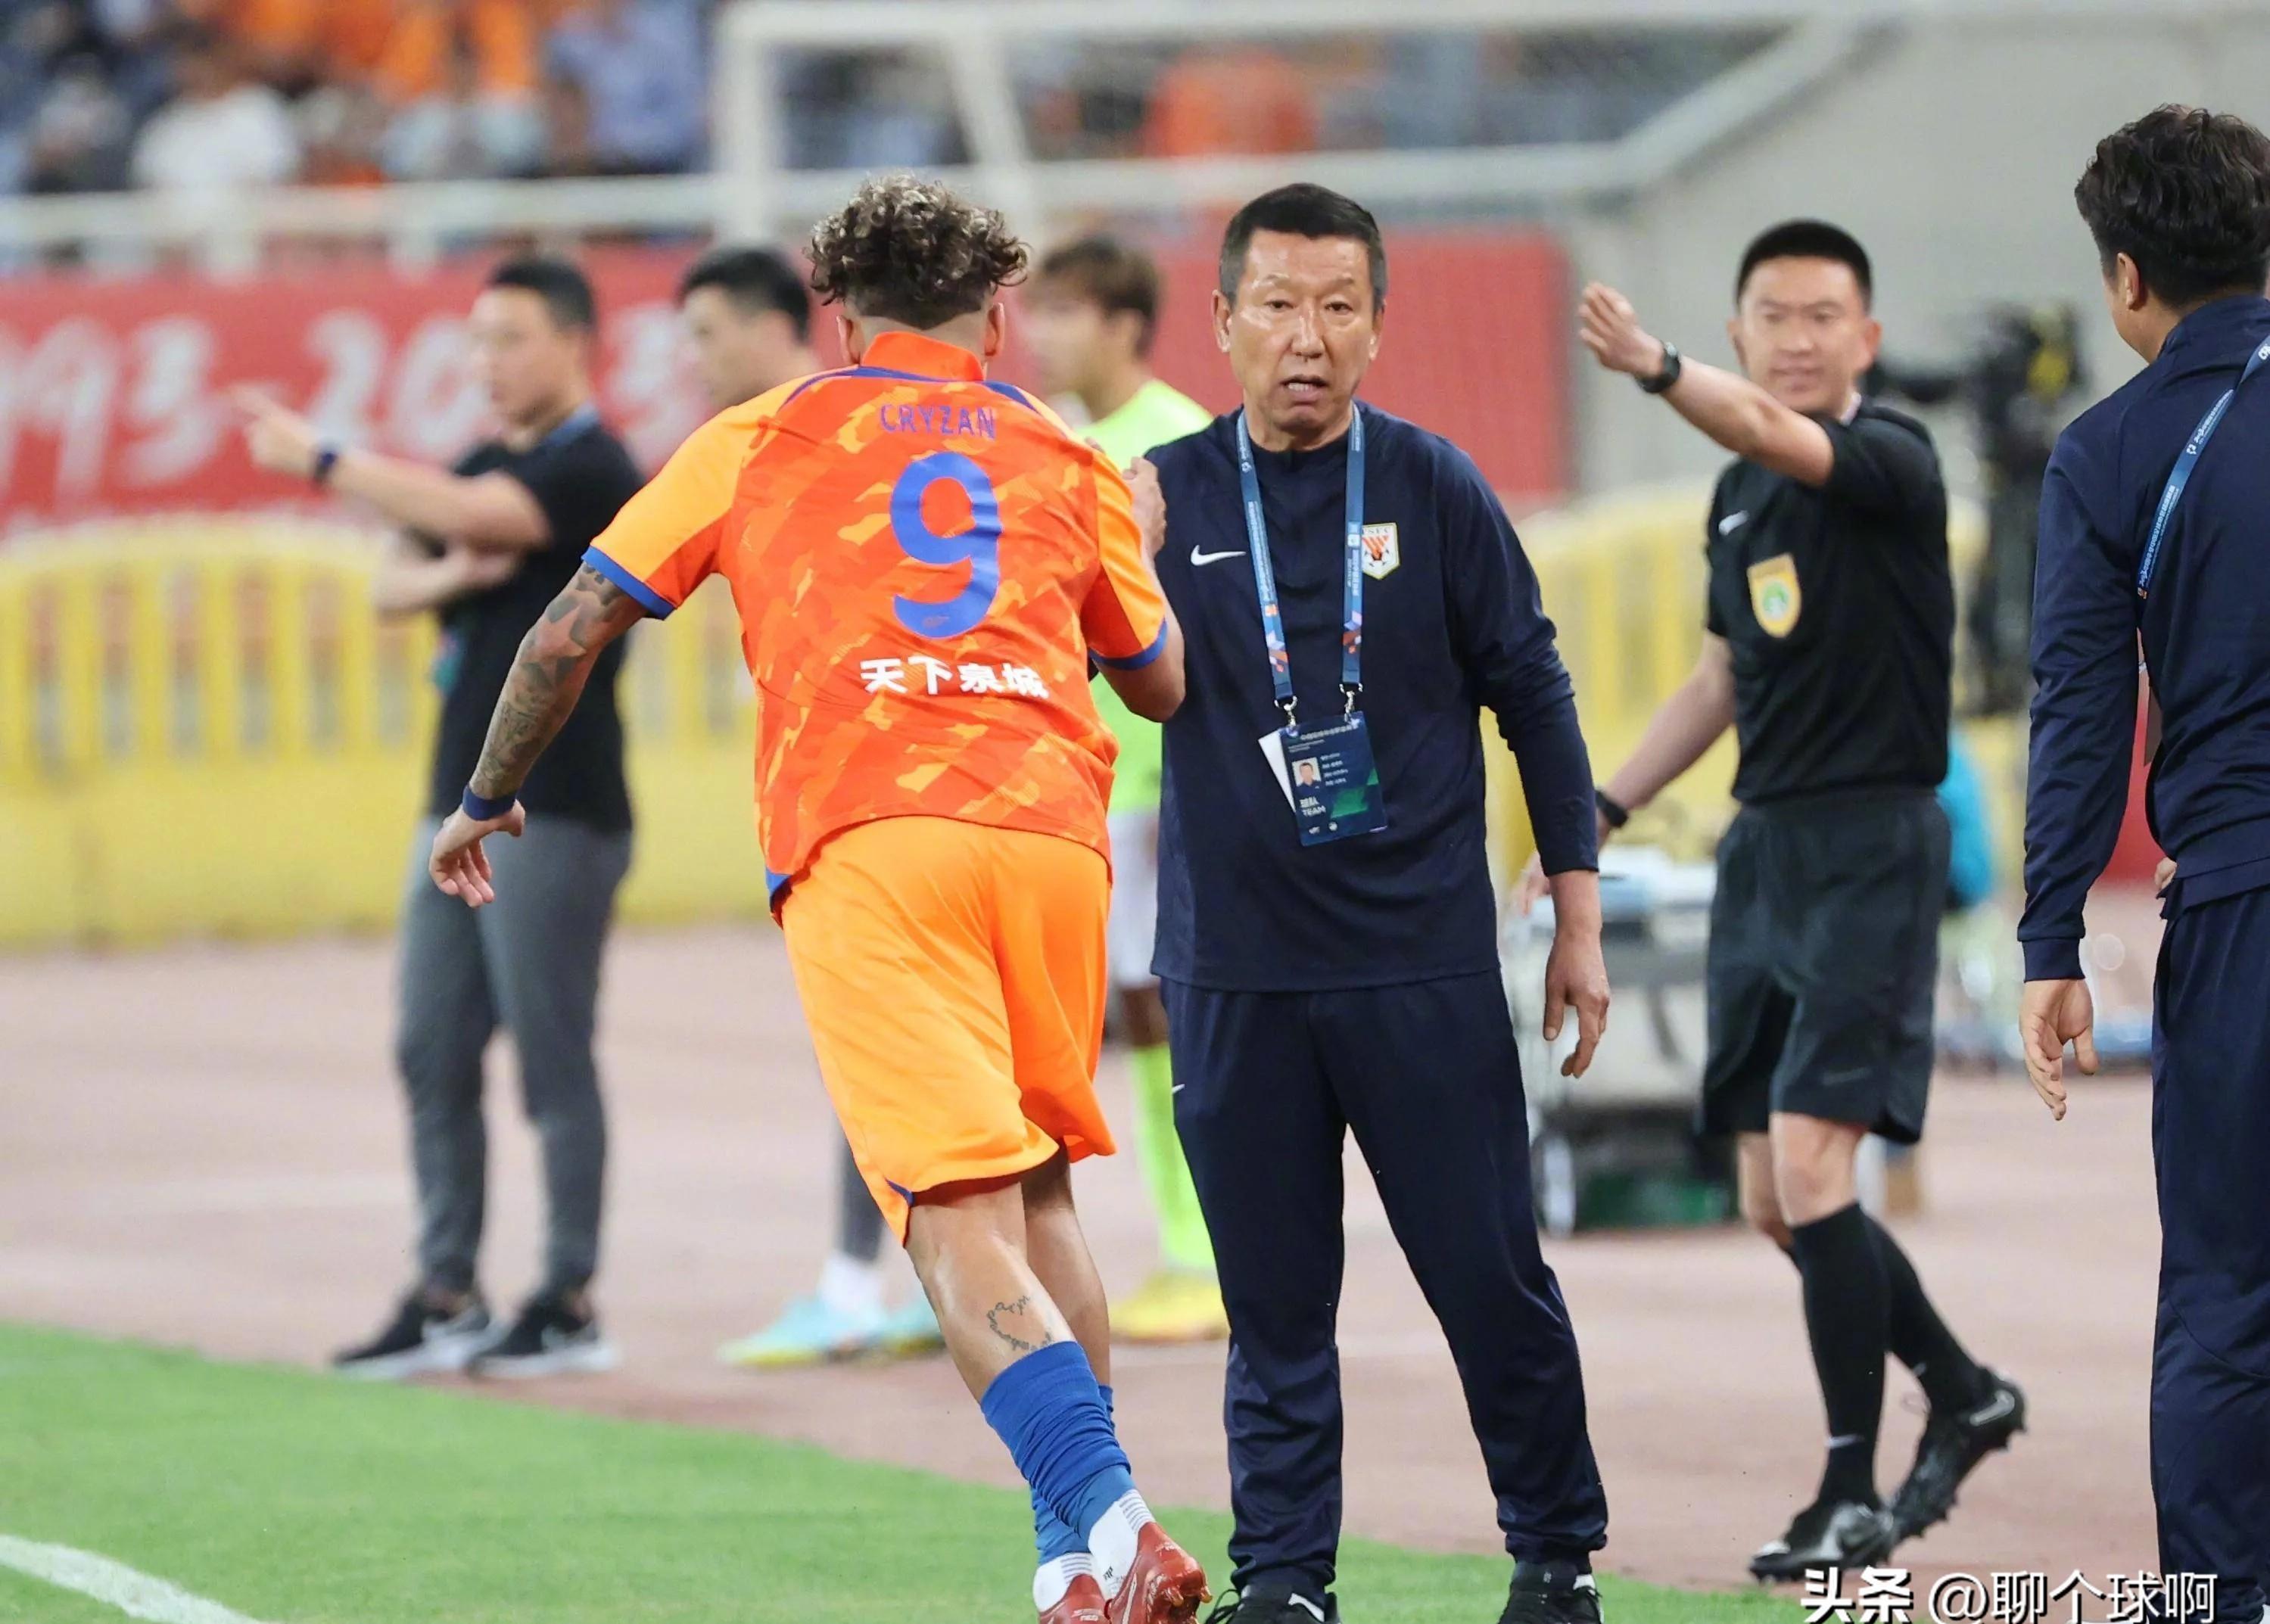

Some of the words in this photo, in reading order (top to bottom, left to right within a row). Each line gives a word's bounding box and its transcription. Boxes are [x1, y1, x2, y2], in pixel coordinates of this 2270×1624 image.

[880, 403, 996, 440] CRYZAN
[889, 450, 1002, 639] 9
[860, 654, 1050, 699] 天下泉城
